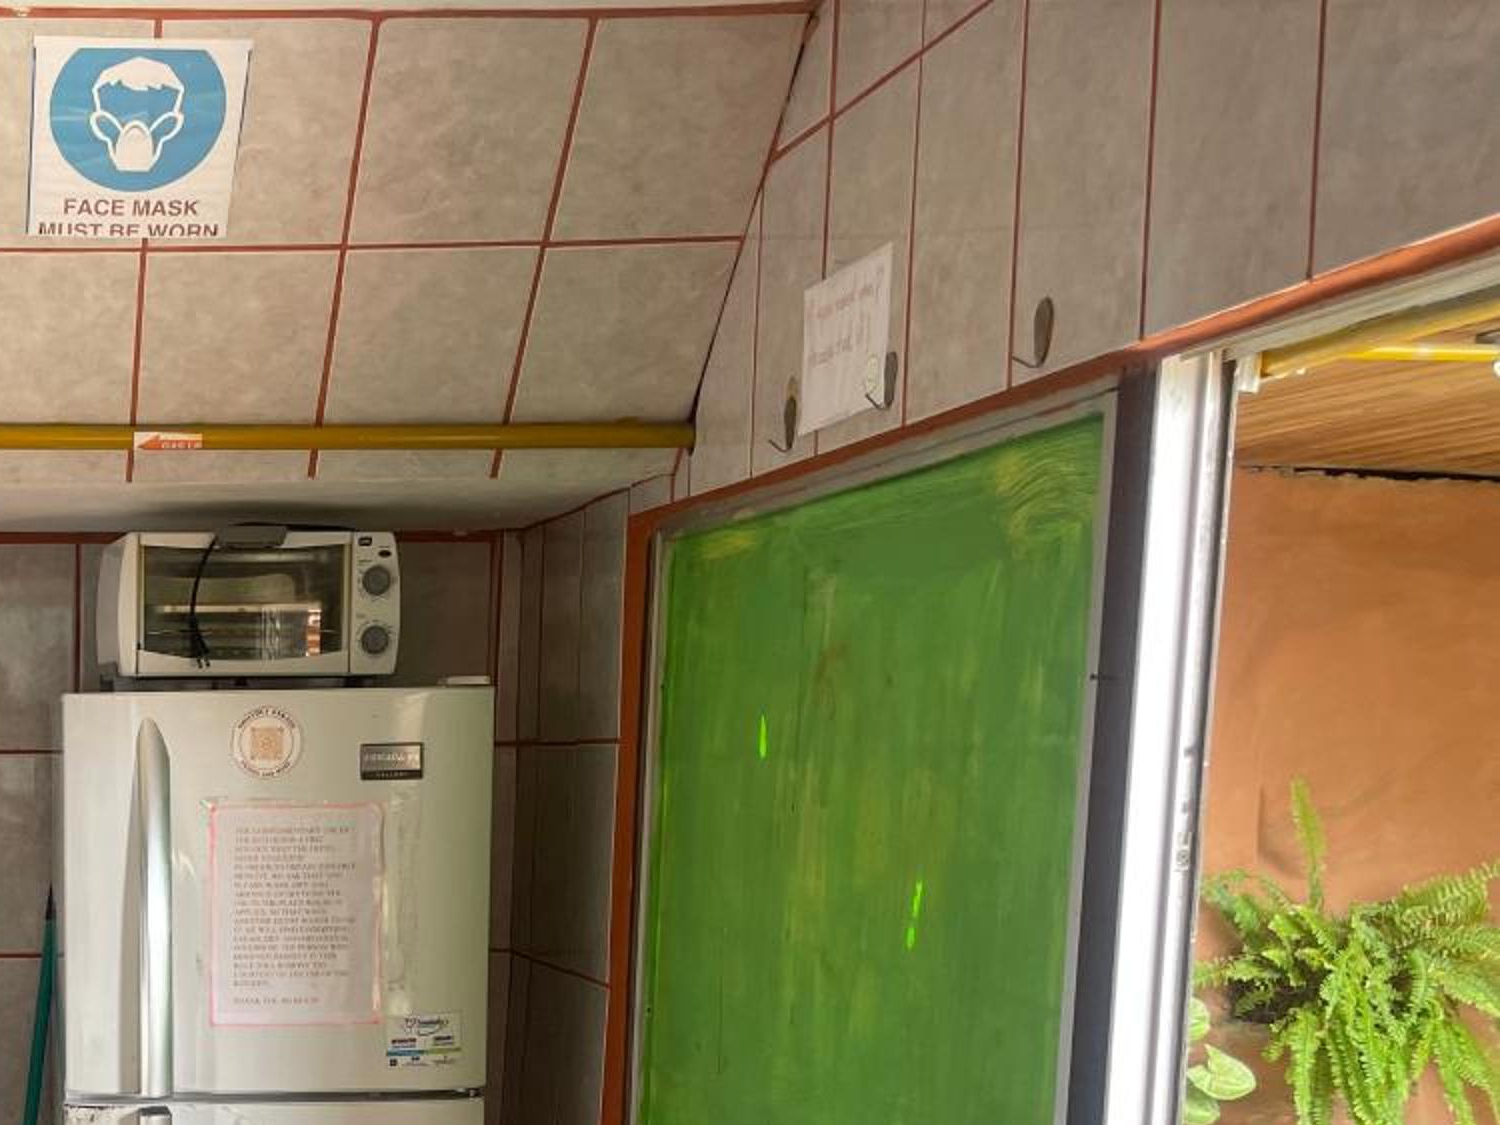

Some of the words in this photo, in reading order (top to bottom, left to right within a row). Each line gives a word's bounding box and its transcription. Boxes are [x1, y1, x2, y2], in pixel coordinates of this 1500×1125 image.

[63, 198, 125, 217] FACE
[132, 199, 198, 217] MASK
[38, 221, 102, 236] MUST
[148, 223, 219, 238] WORN
